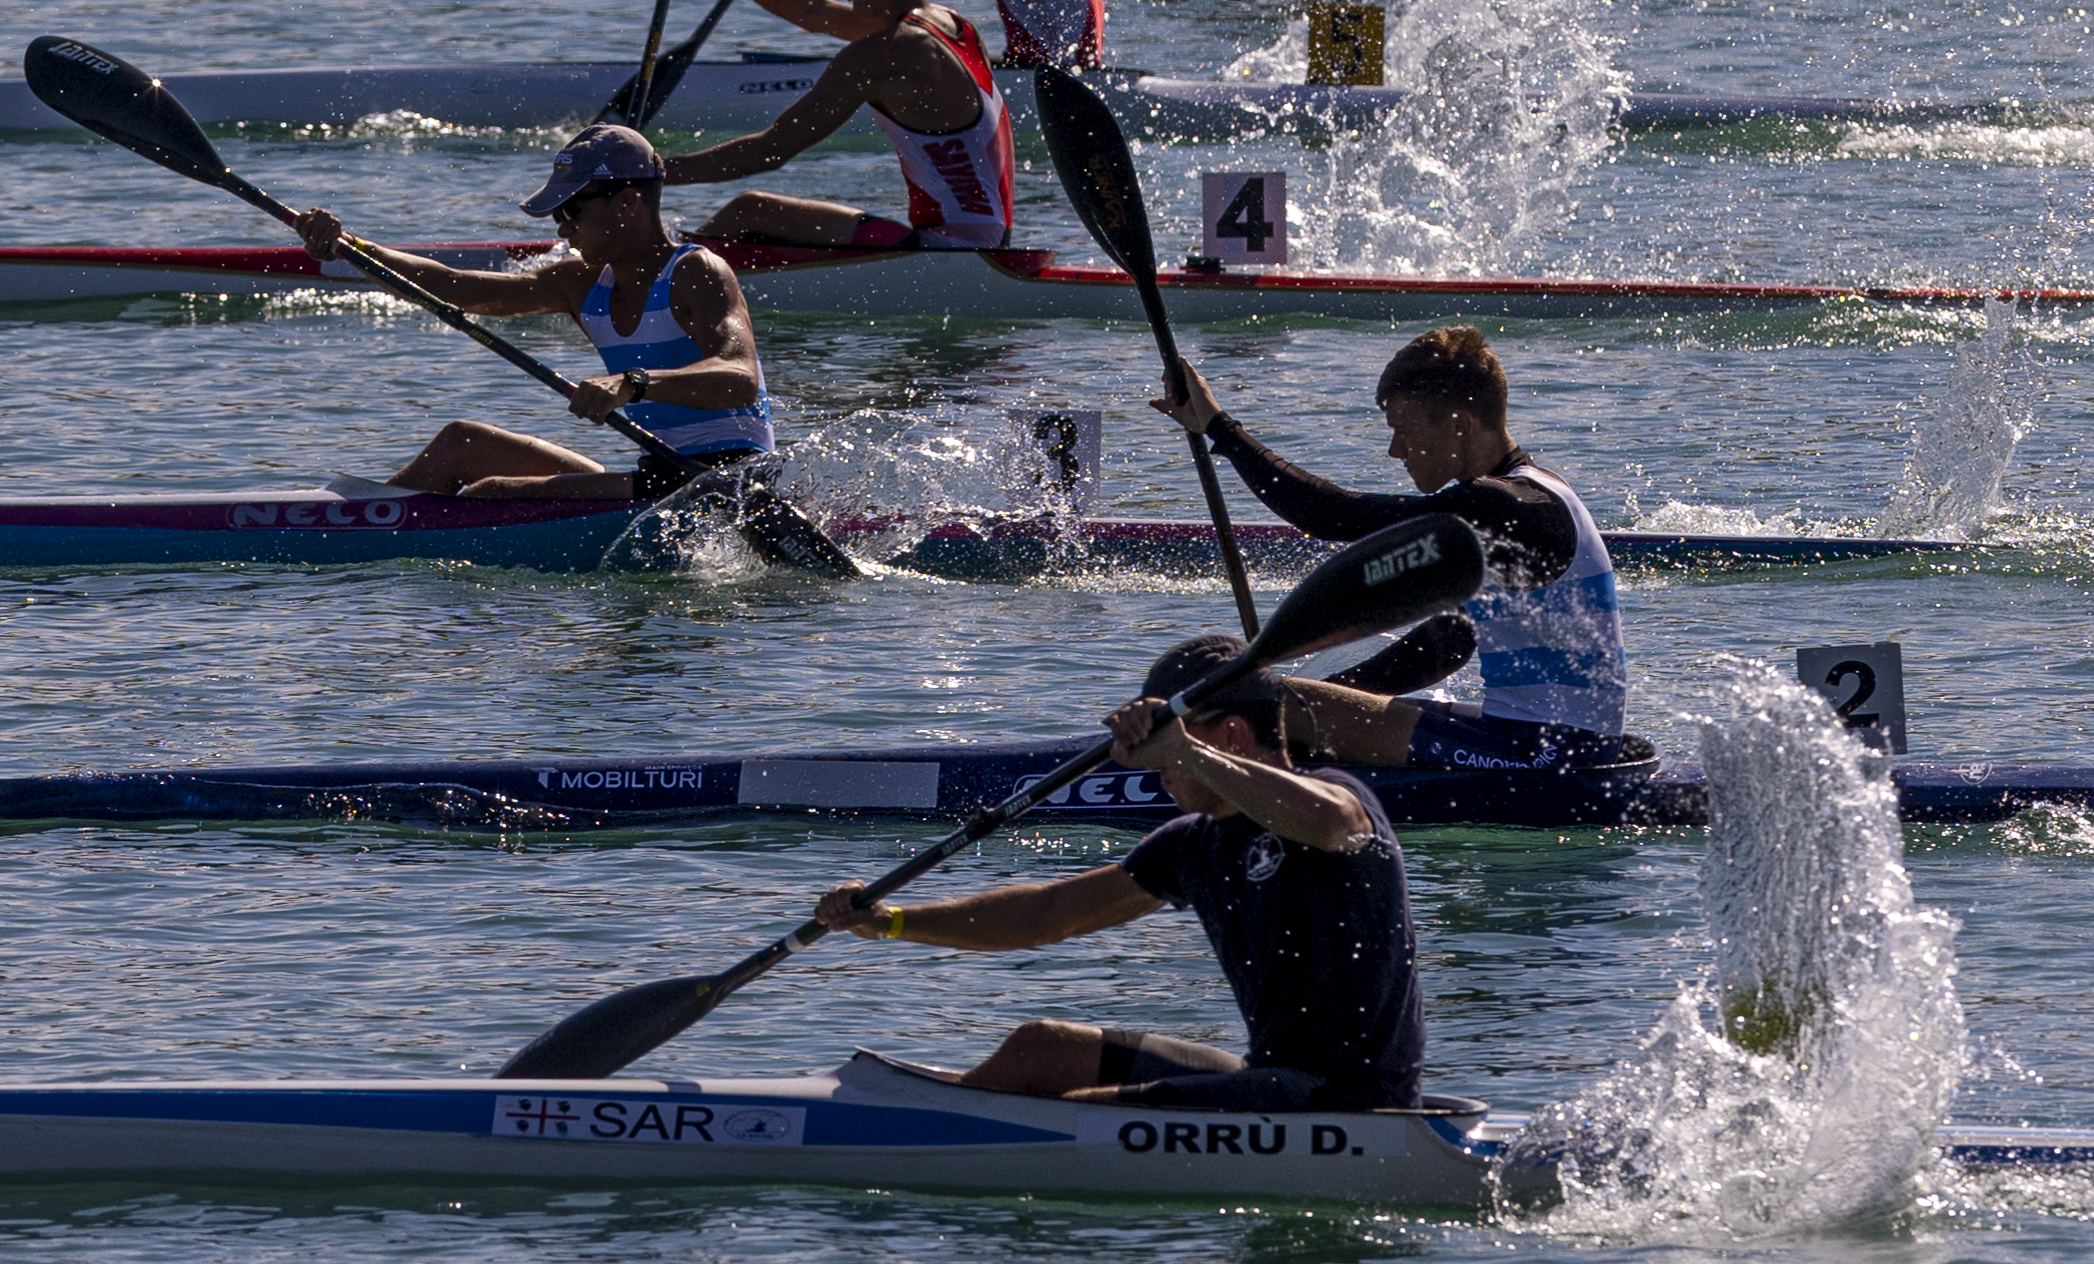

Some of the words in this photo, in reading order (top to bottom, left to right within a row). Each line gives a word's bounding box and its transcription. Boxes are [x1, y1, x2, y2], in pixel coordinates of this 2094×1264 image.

[1331, 11, 1362, 75] 5
[1216, 176, 1274, 252] 4
[1033, 414, 1079, 495] 3
[233, 502, 401, 525] NELO
[1825, 660, 1880, 728] 2
[561, 771, 703, 789] MOBILTURI
[589, 1102, 715, 1142] SAR
[1118, 1115, 1287, 1155] ORRÙ
[1311, 1124, 1365, 1156] D.
